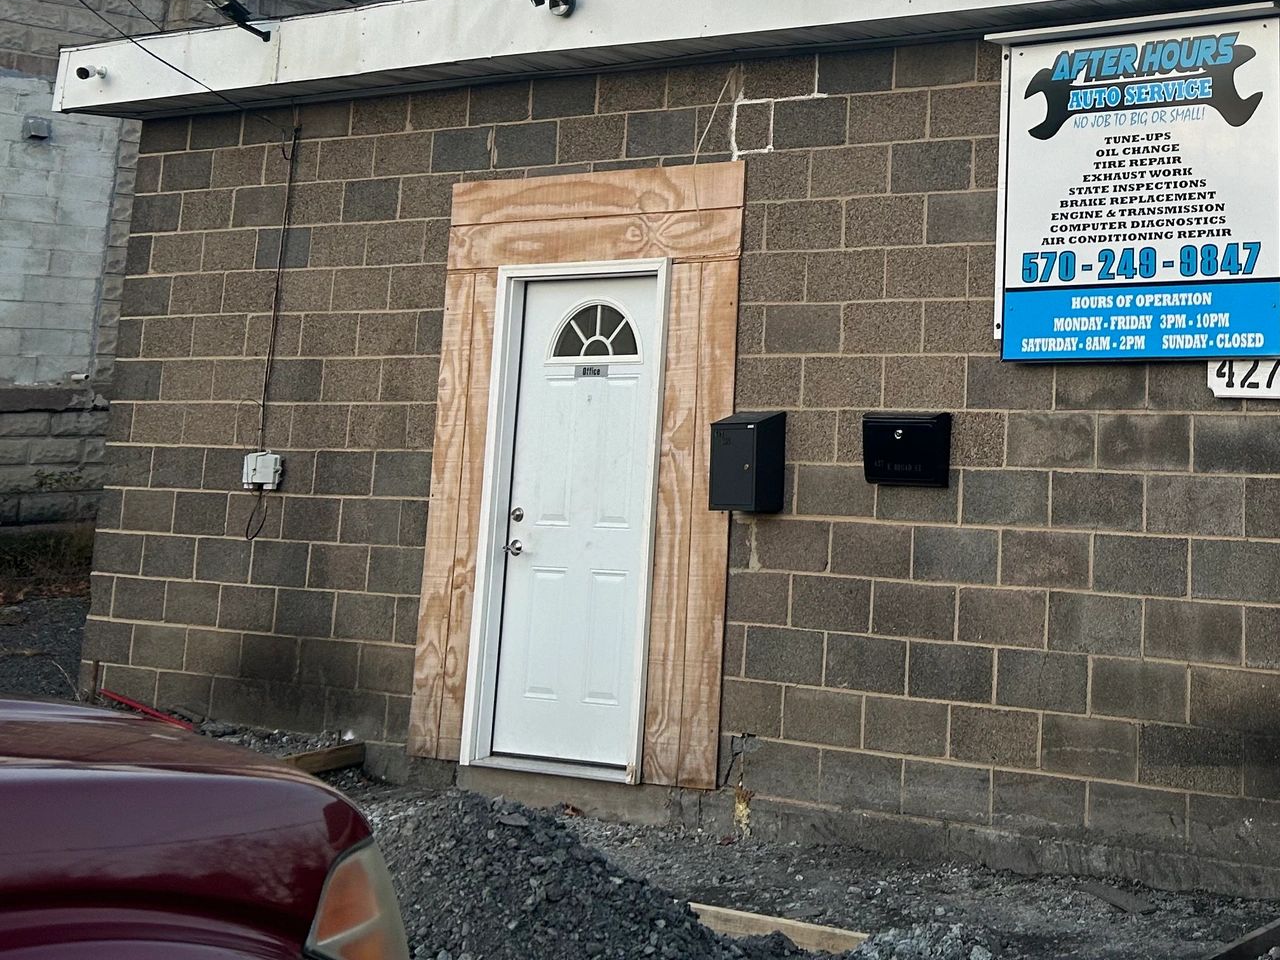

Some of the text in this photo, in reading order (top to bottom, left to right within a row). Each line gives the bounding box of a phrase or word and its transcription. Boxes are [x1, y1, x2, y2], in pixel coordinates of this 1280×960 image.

[1051, 33, 1239, 81] AFTER HOURS
[1068, 77, 1212, 110] AUTO SERVICE
[1073, 106, 1205, 129] NO JOB TO BIG OR SMALL!
[1104, 132, 1171, 144] TUNE-UPS
[1096, 144, 1180, 157] OIL CHANGE
[1093, 156, 1182, 169] TIRE REPAIR
[1083, 167, 1193, 182] EXHAUST WORK
[1069, 179, 1207, 195] STATE INSPECTIONS
[1060, 191, 1216, 208] BRAKE REPLACEMENT
[1051, 203, 1225, 221] ENGINE & TRANSMISSION
[1050, 216, 1226, 233] COMPUTER DIAGNOSTICS
[1041, 228, 1232, 246] AIR CONDITIONING REPAIR
[1072, 292, 1212, 309] HOURS OF OPERATION
[1160, 314, 1187, 329] 3PM
[1196, 313, 1230, 328] 10PM
[1085, 336, 1110, 351] 8AM
[1119, 335, 1146, 350] 2PM
[582, 366, 600, 376] Office
